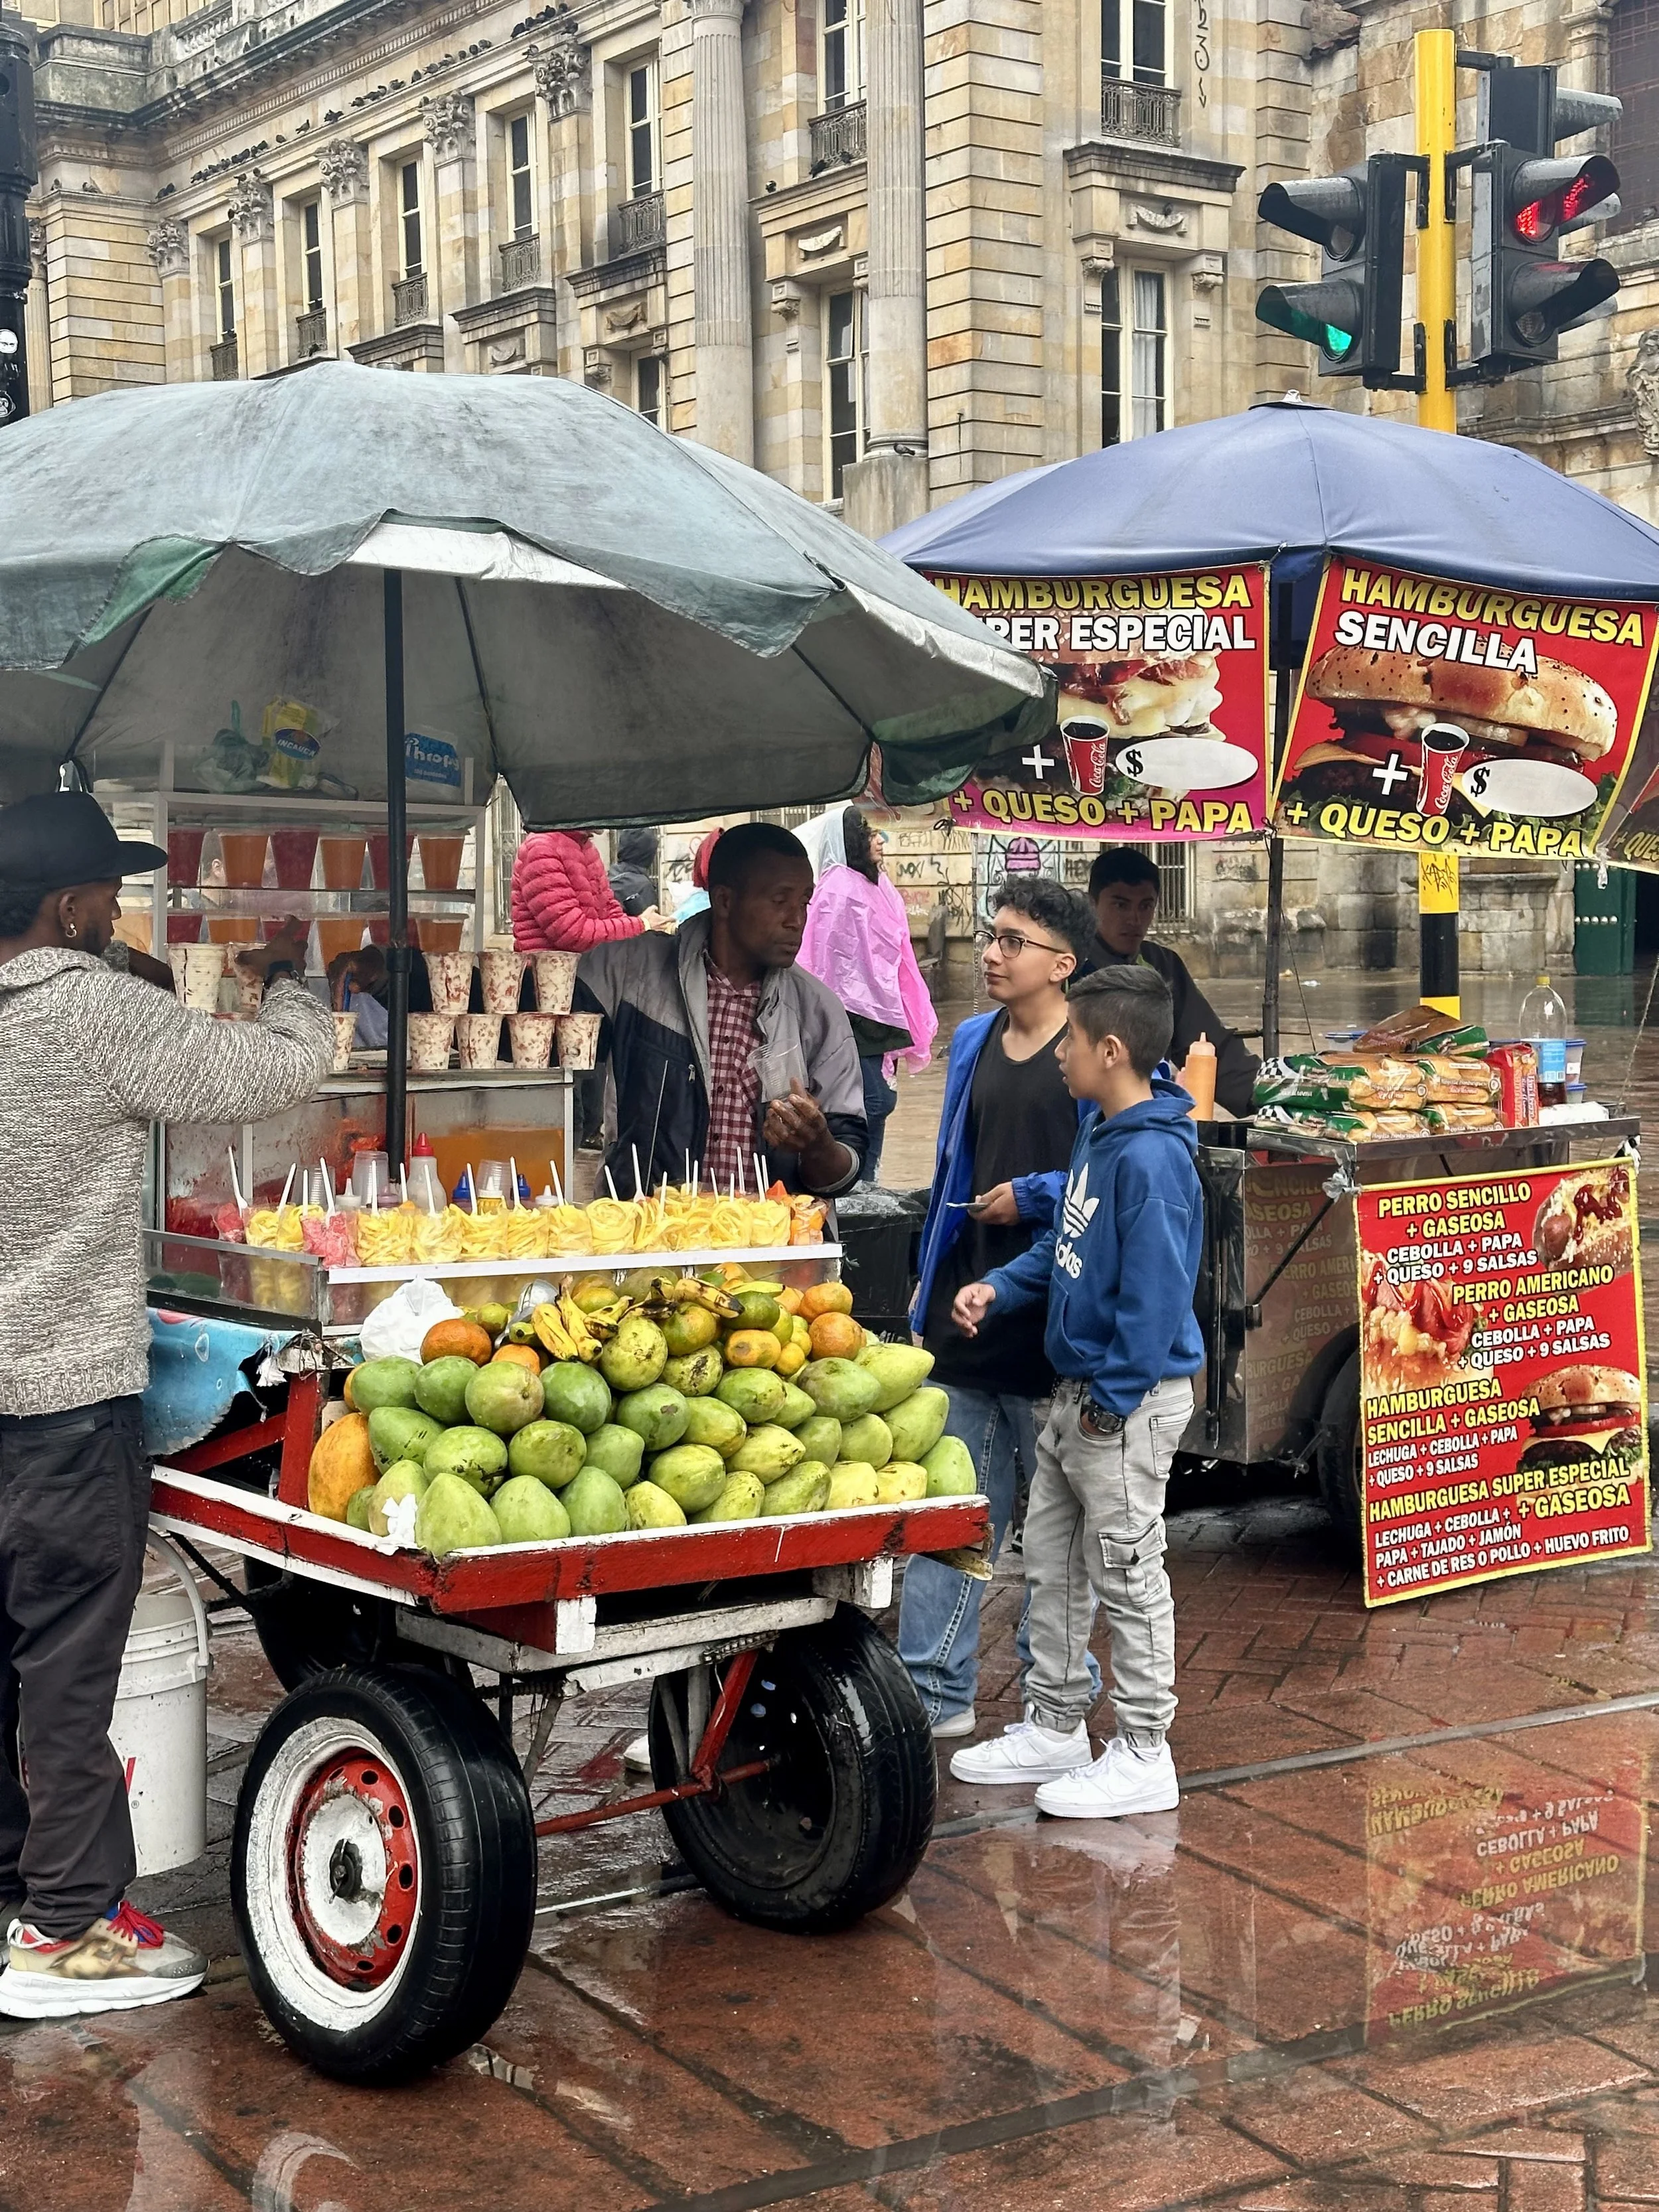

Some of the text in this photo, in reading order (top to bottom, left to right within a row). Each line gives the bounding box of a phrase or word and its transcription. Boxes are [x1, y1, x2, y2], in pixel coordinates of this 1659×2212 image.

[935, 575, 1252, 609] HAMBURGUESA
[1342, 569, 1644, 646] HAMBURGUESA
[977, 616, 1255, 650] PER ESPECIAL
[1335, 612, 1537, 672] SENCILLA
[1022, 745, 1054, 778] +
[1125, 749, 1143, 778] $
[1373, 753, 1407, 795] +
[1471, 767, 1490, 796] $
[954, 790, 1254, 833] + QUESO + PAPA
[1287, 802, 1583, 857] + QUESO + PAPA
[1379, 1183, 1531, 1217] PERRO SENCILLO
[1407, 1211, 1505, 1238] + GASEOSA
[1388, 1233, 1523, 1264] CEBOLLA + PAPA
[1374, 1250, 1538, 1285] + QUESO + 9 SALSAS
[1454, 1266, 1614, 1305] PERRO AMERICANO
[1489, 1295, 1579, 1322] + GASEOSA
[1472, 1317, 1594, 1348] CEBOLLA + PAPA
[1459, 1333, 1611, 1368] + QUESO + 9 SALSAS
[1367, 1379, 1502, 1418] HAMBURGUESA
[1368, 1398, 1540, 1445] SENCILLA + GASEOSA
[1368, 1426, 1517, 1467] LECHUGA + CEBOLLA + PAPA
[1368, 1454, 1478, 1487] + QUESO + 9 SALSAS
[1370, 1457, 1630, 1522] HAMBURGUESA SUPER ESPECIAL
[1519, 1485, 1630, 1518] + GASEOSA
[1375, 1508, 1510, 1548] LECHUGA + CEBOLLA +
[1375, 1521, 1522, 1569] PAPA + TAJADO + JAMÓN
[1377, 1526, 1629, 1587] + CARNE DE RES O POLLO + HUEVO FRITO
